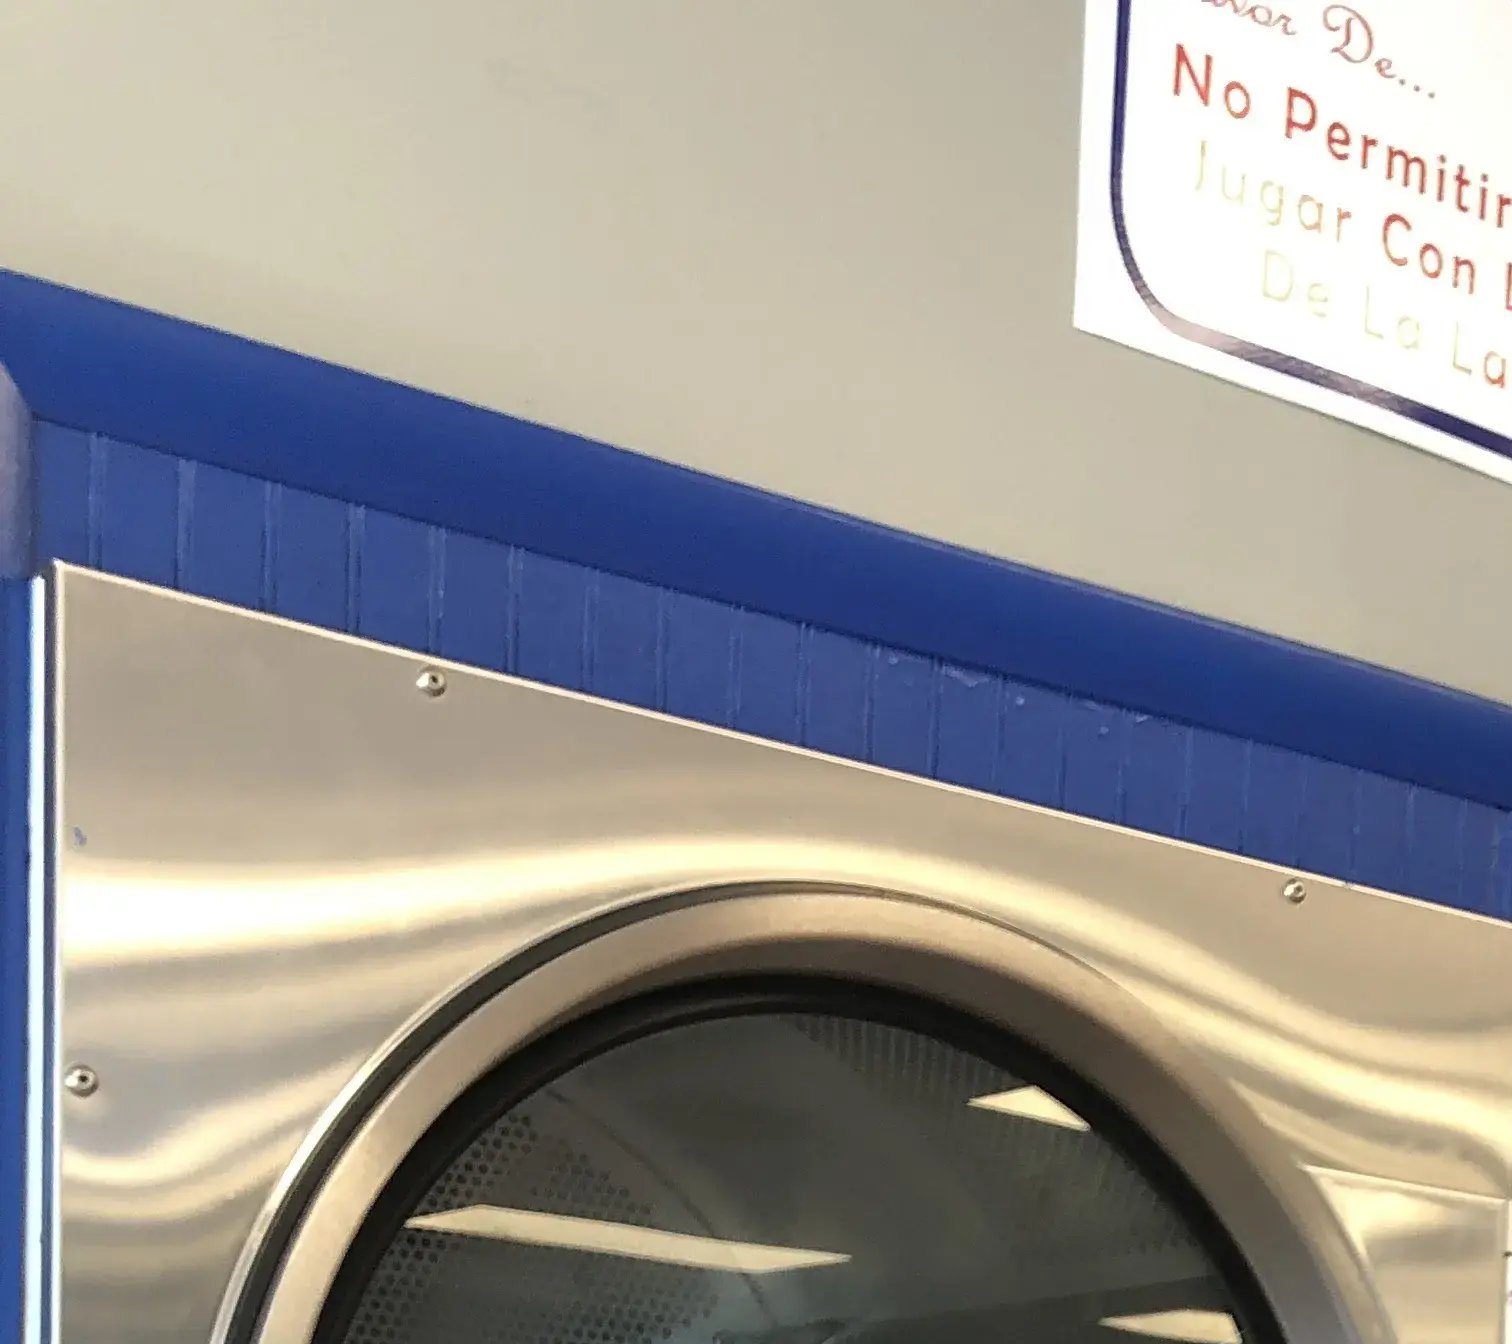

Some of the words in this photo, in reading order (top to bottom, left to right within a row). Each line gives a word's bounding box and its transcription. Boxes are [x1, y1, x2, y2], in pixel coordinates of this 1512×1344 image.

[1174, 43, 1252, 119] No
[1285, 86, 1512, 228] Permitir
[1195, 140, 1352, 242] Jugar
[1383, 213, 1476, 295] Con
[1262, 249, 1329, 319] De
[1364, 285, 1421, 351] La
